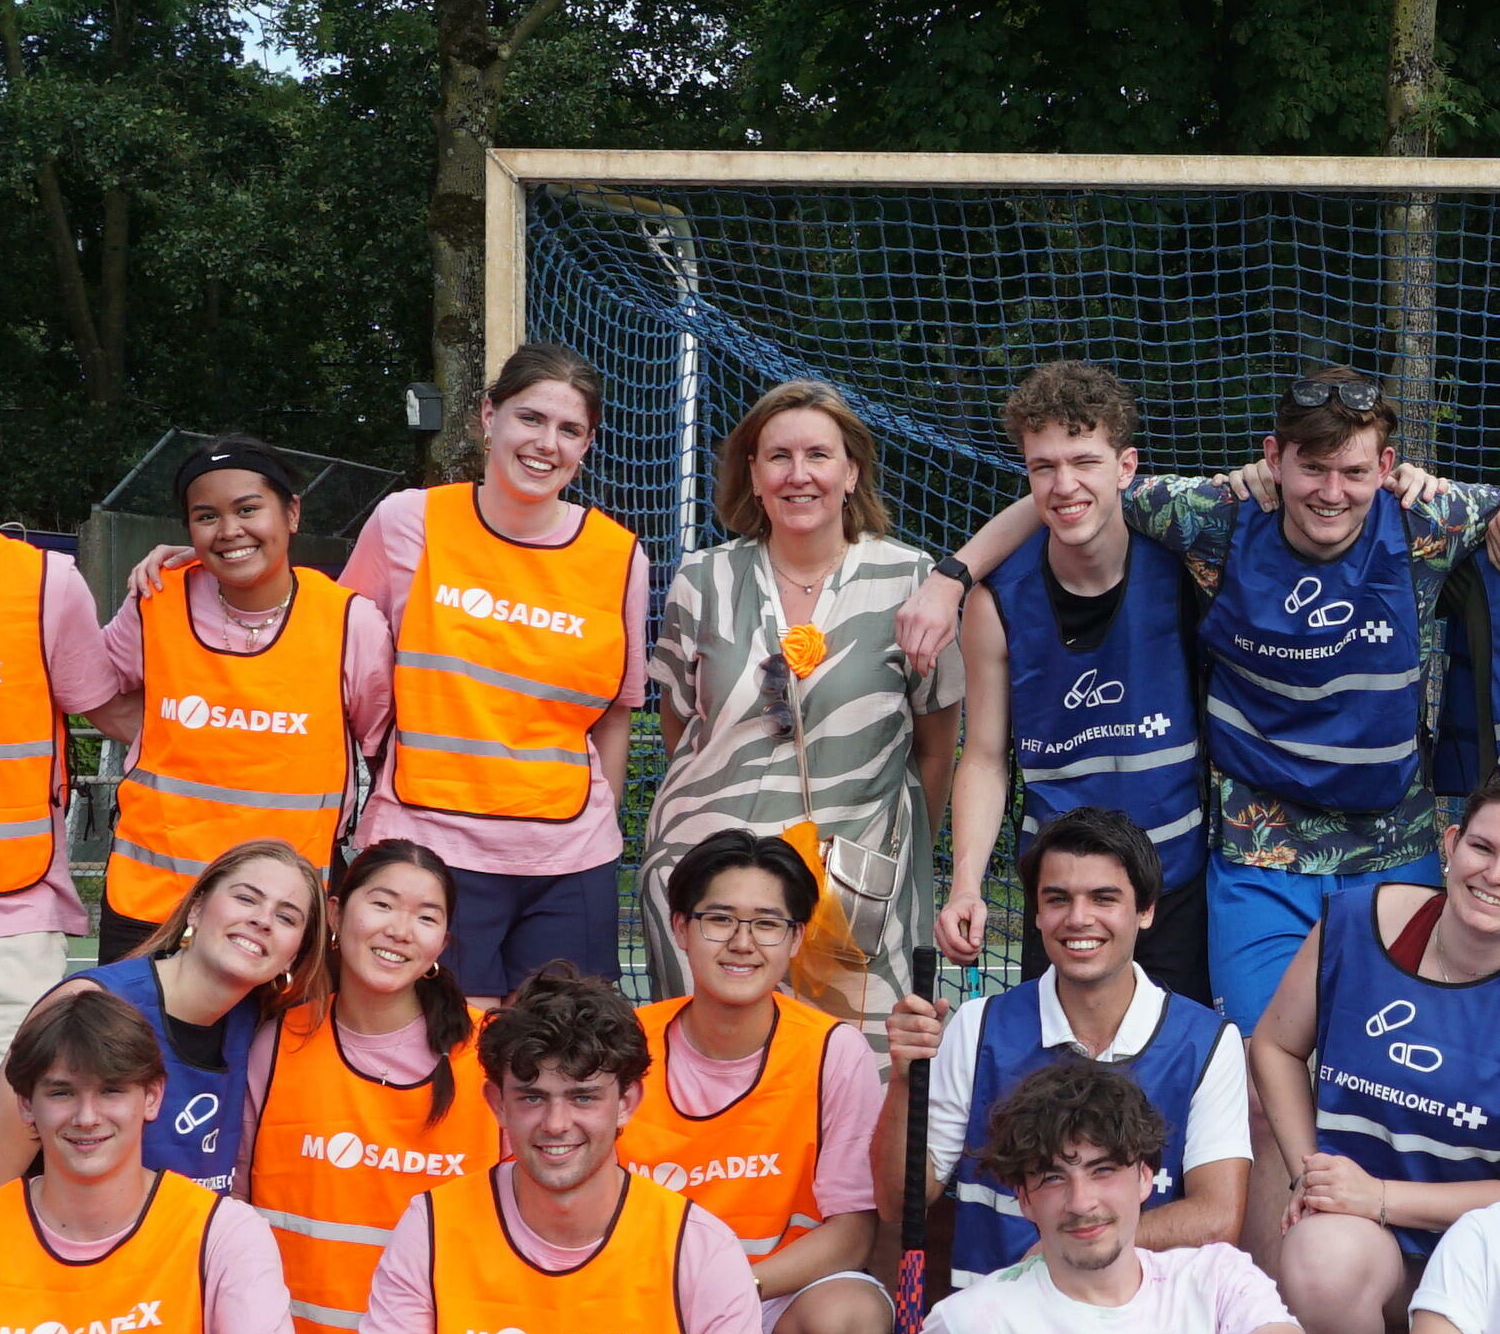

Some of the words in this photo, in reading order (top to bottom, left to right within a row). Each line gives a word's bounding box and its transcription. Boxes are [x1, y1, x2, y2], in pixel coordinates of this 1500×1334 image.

[1234, 634, 1254, 651] HET
[1021, 738, 1043, 753] HET
[1045, 724, 1136, 754] APOTHEEKLOKET
[1320, 1065, 1334, 1081] ET
[1335, 1071, 1445, 1117] APOTHEEKLOKET
